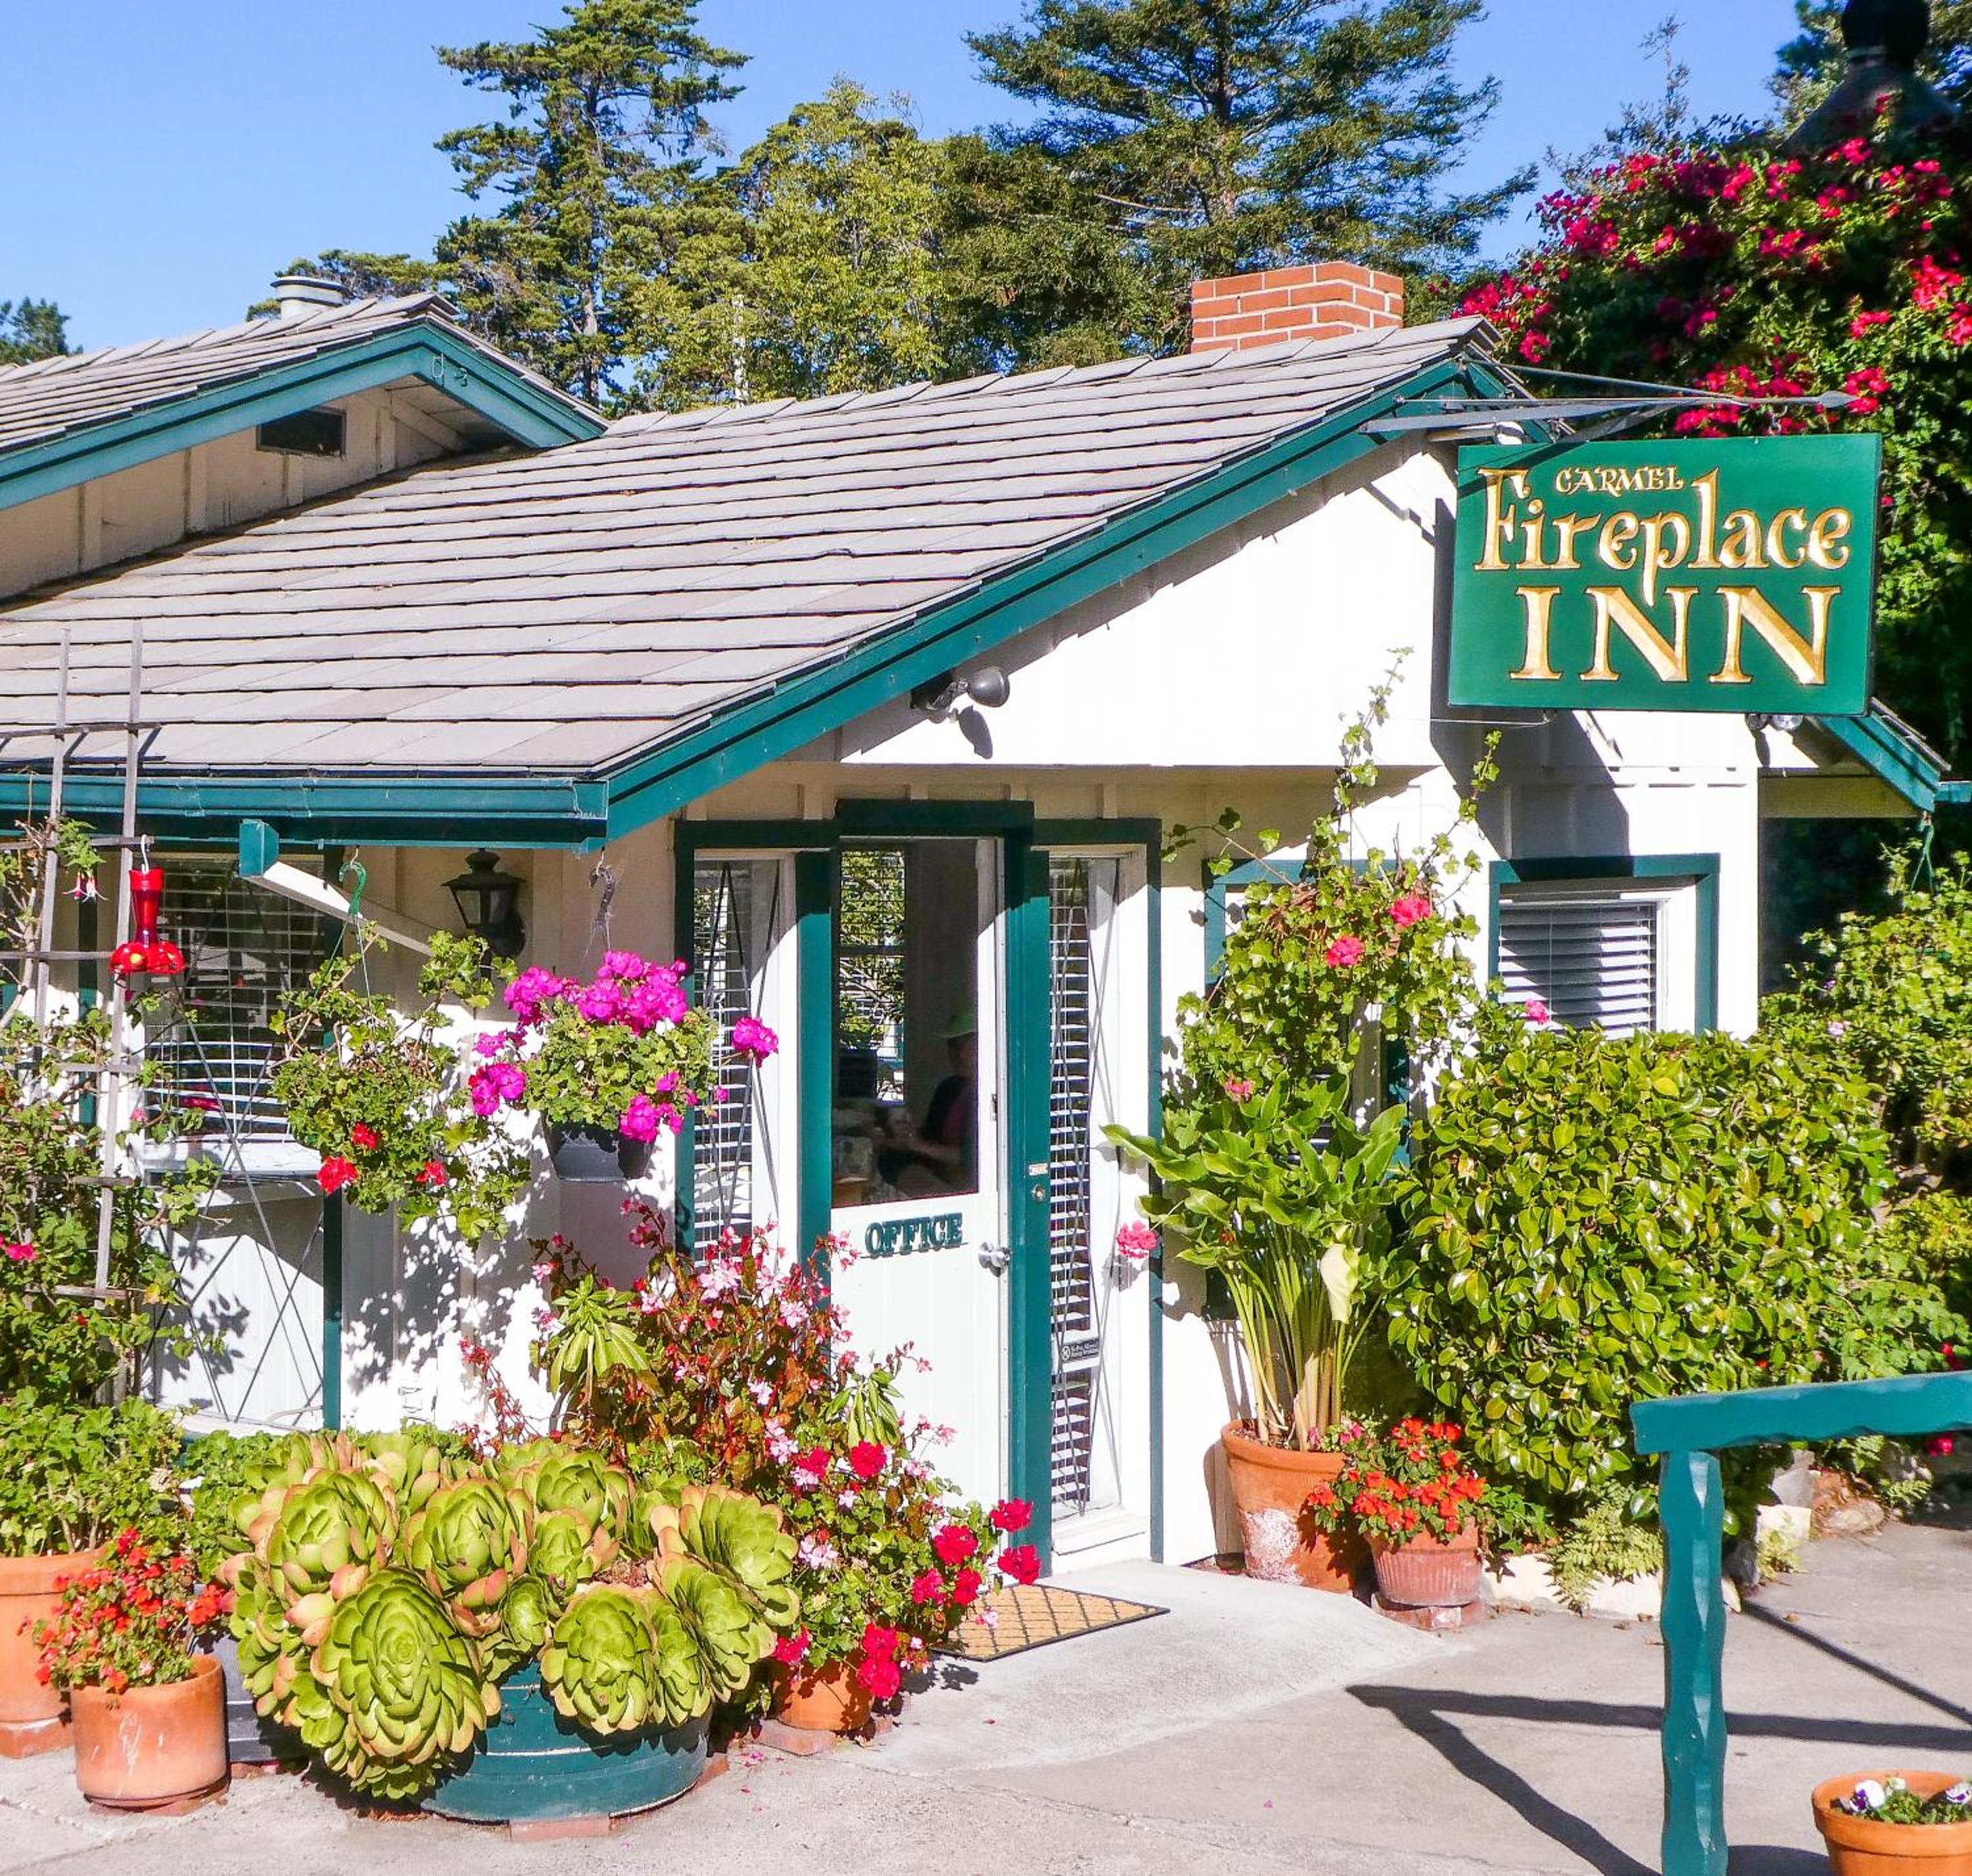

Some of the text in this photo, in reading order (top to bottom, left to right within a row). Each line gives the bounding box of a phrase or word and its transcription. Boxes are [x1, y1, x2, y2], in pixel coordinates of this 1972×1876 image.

[1555, 465, 1685, 498] CARMEL
[1474, 466, 1852, 607] Fireplace
[1509, 585, 1841, 685] INN
[865, 1212, 962, 1256] OFFICE
